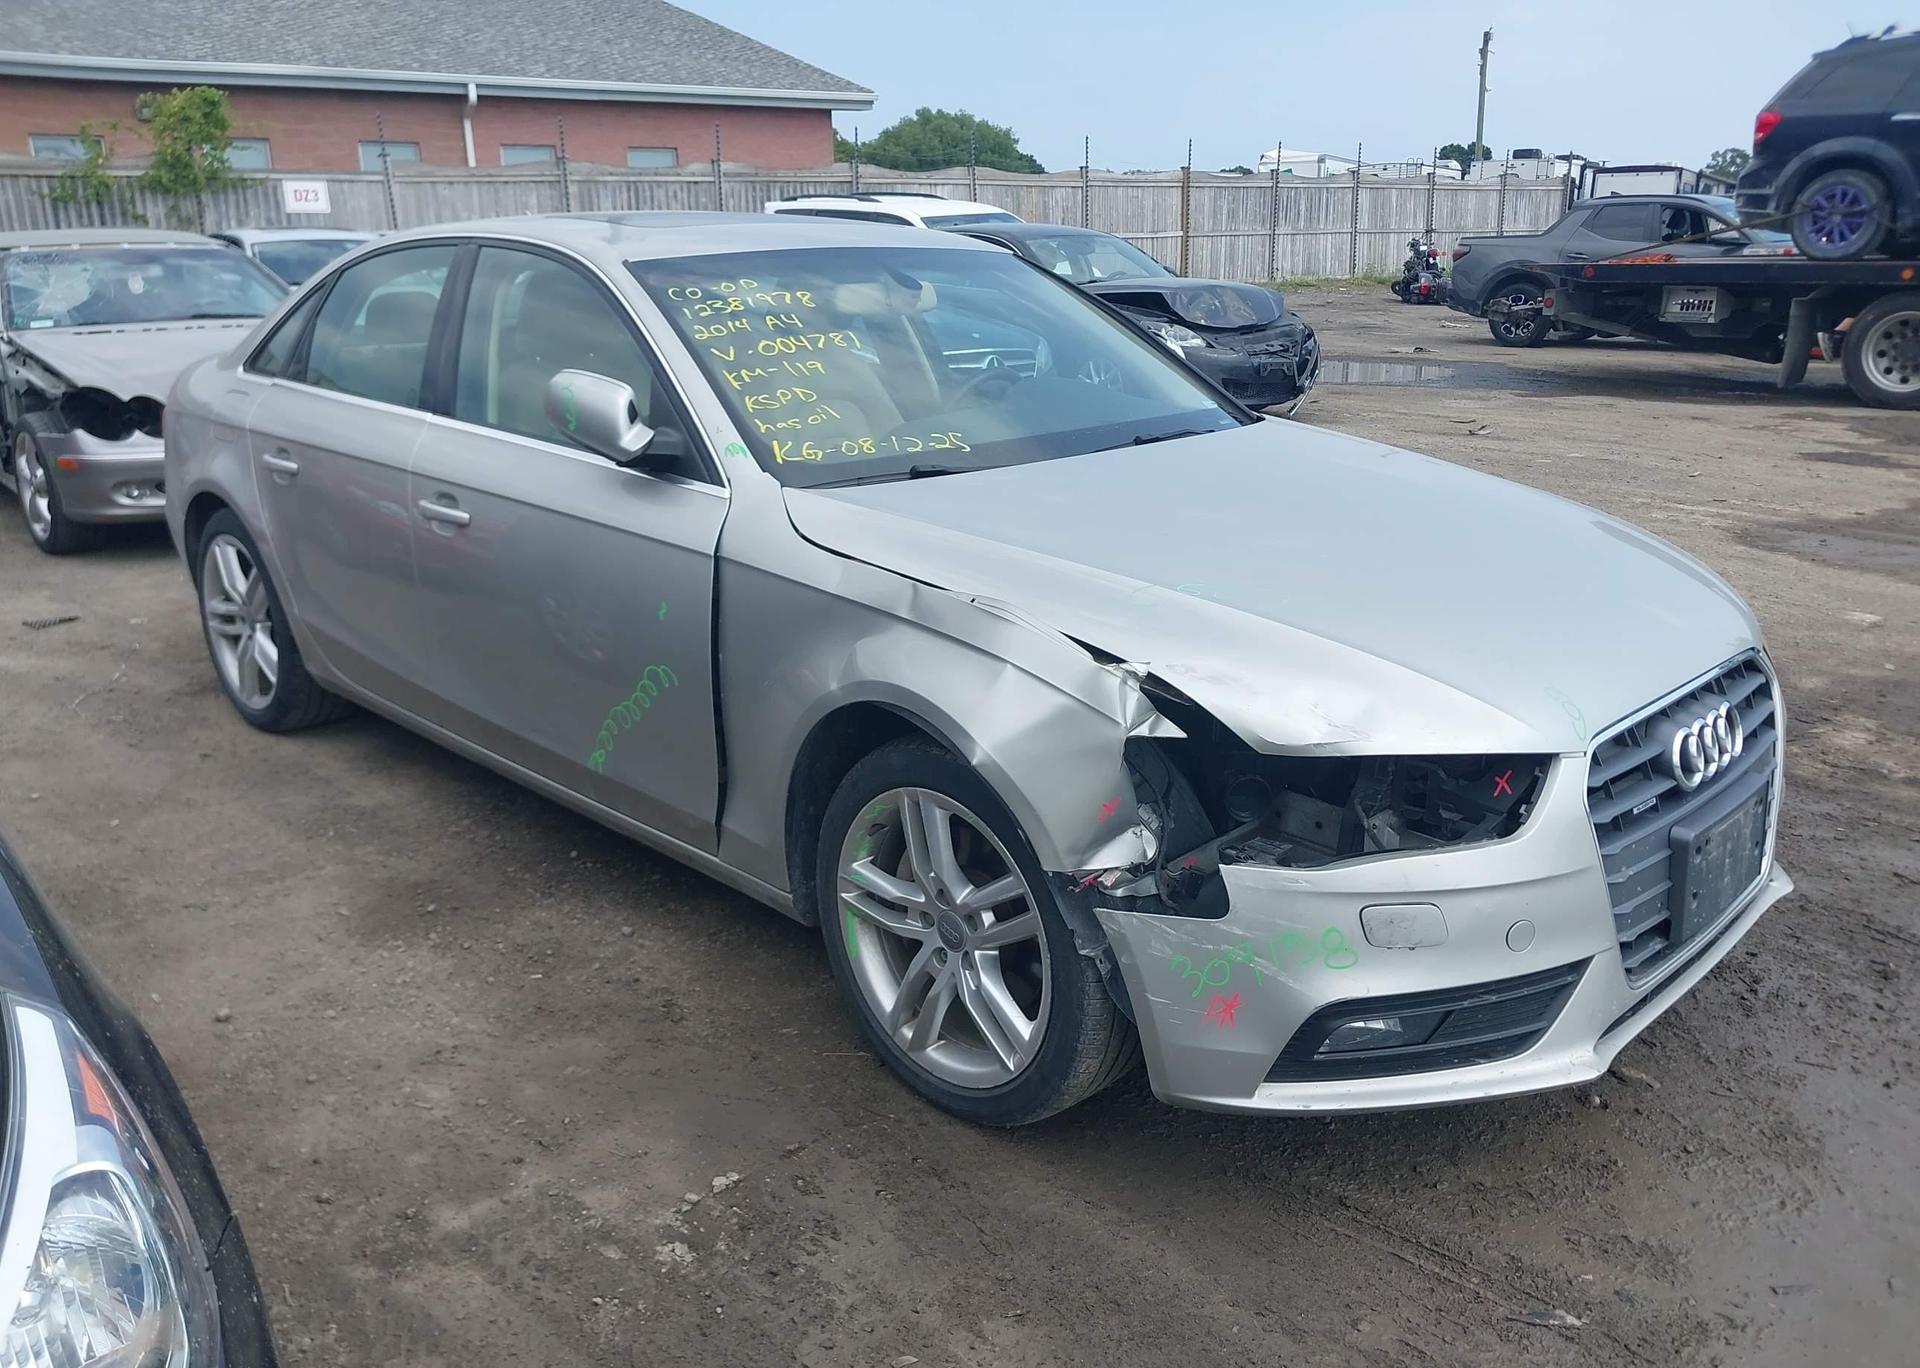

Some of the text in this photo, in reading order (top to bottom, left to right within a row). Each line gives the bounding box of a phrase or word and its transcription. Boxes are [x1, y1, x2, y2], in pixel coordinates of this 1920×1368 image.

[682, 291, 817, 320] 12381978
[693, 312, 804, 341] 2014 A4
[745, 386, 818, 413] KSPD
